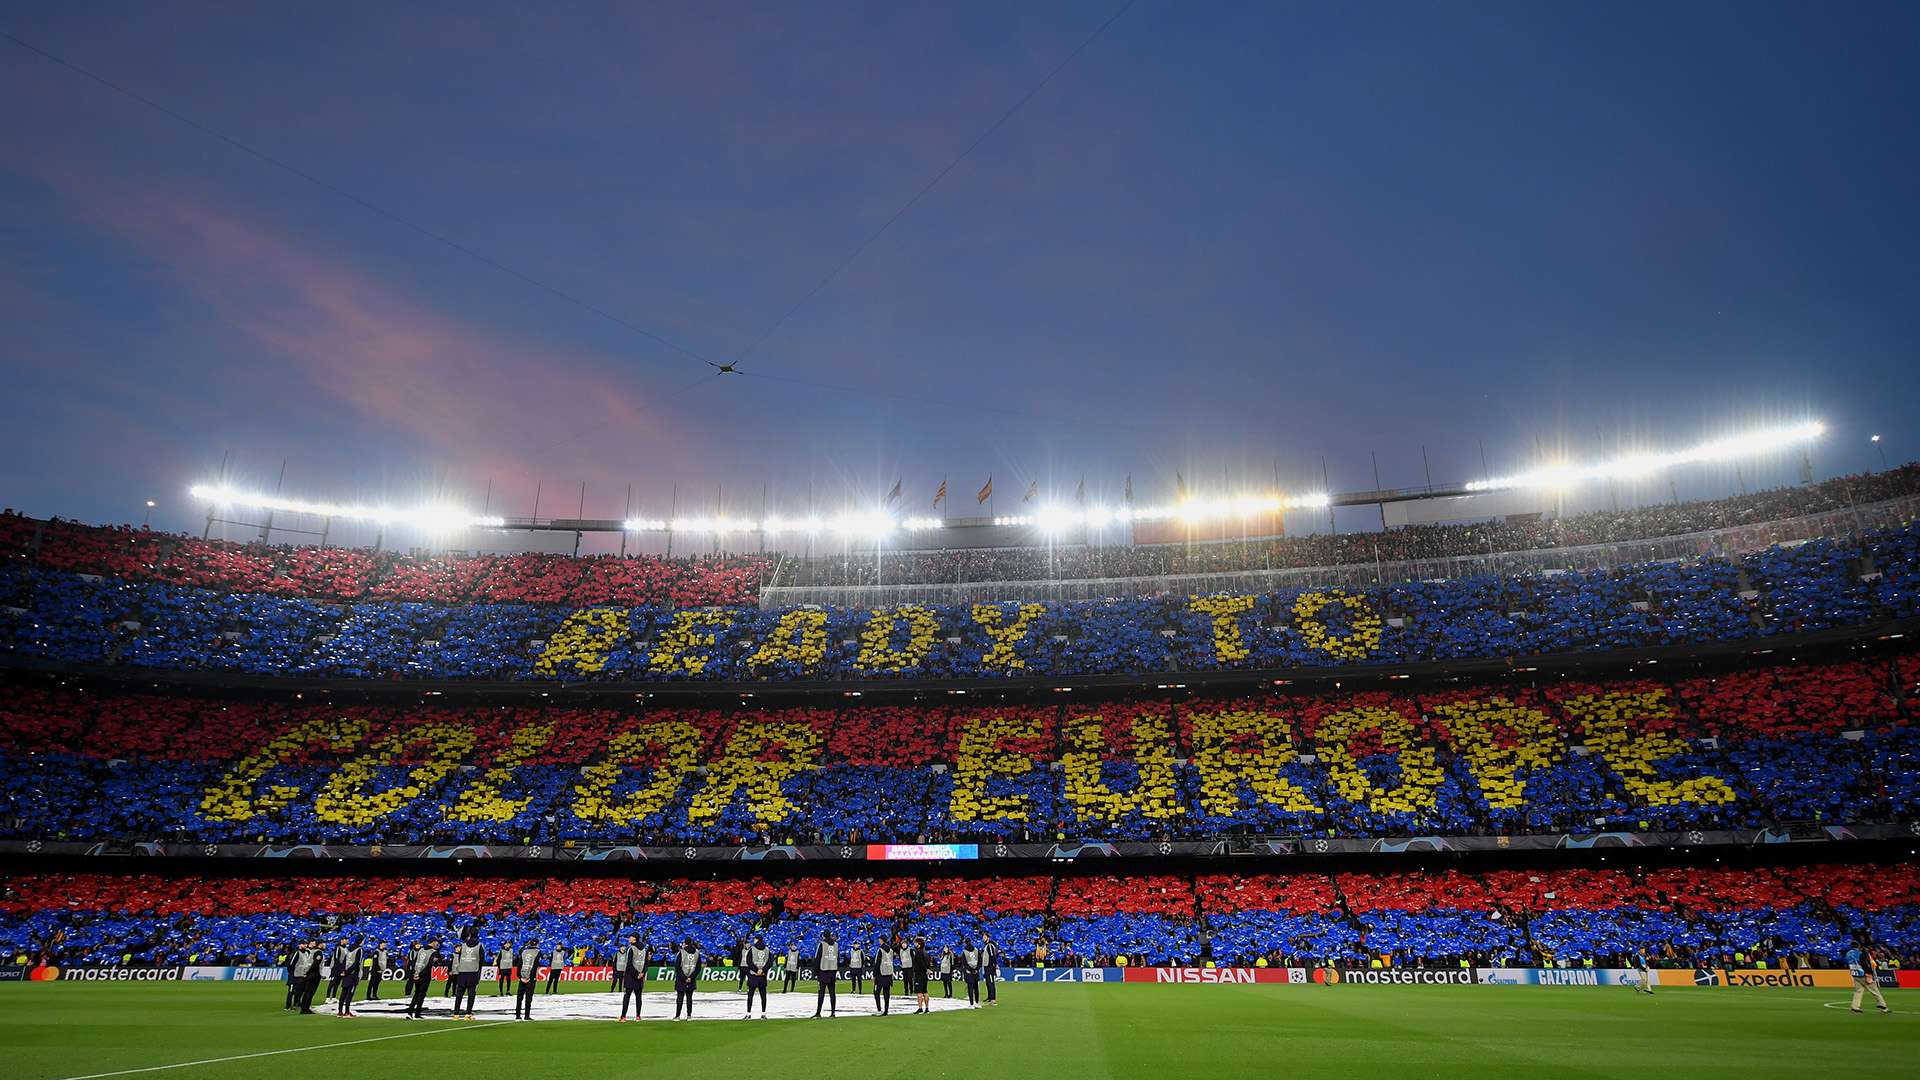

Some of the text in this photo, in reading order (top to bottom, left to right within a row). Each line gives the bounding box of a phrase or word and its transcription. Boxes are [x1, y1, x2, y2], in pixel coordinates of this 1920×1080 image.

[536, 589, 1383, 674] READY TO
[200, 689, 1735, 826] COLOR EUROPE
[65, 965, 179, 980] mastercard
[233, 967, 283, 980] GAZPROM
[538, 966, 613, 981] Sntande
[1085, 972, 1100, 980] Pro
[1157, 968, 1256, 983] NISSAN
[1345, 968, 1471, 984] mastercard
[1538, 969, 1597, 985] GAZPROM
[1725, 969, 1814, 986] Expedia
